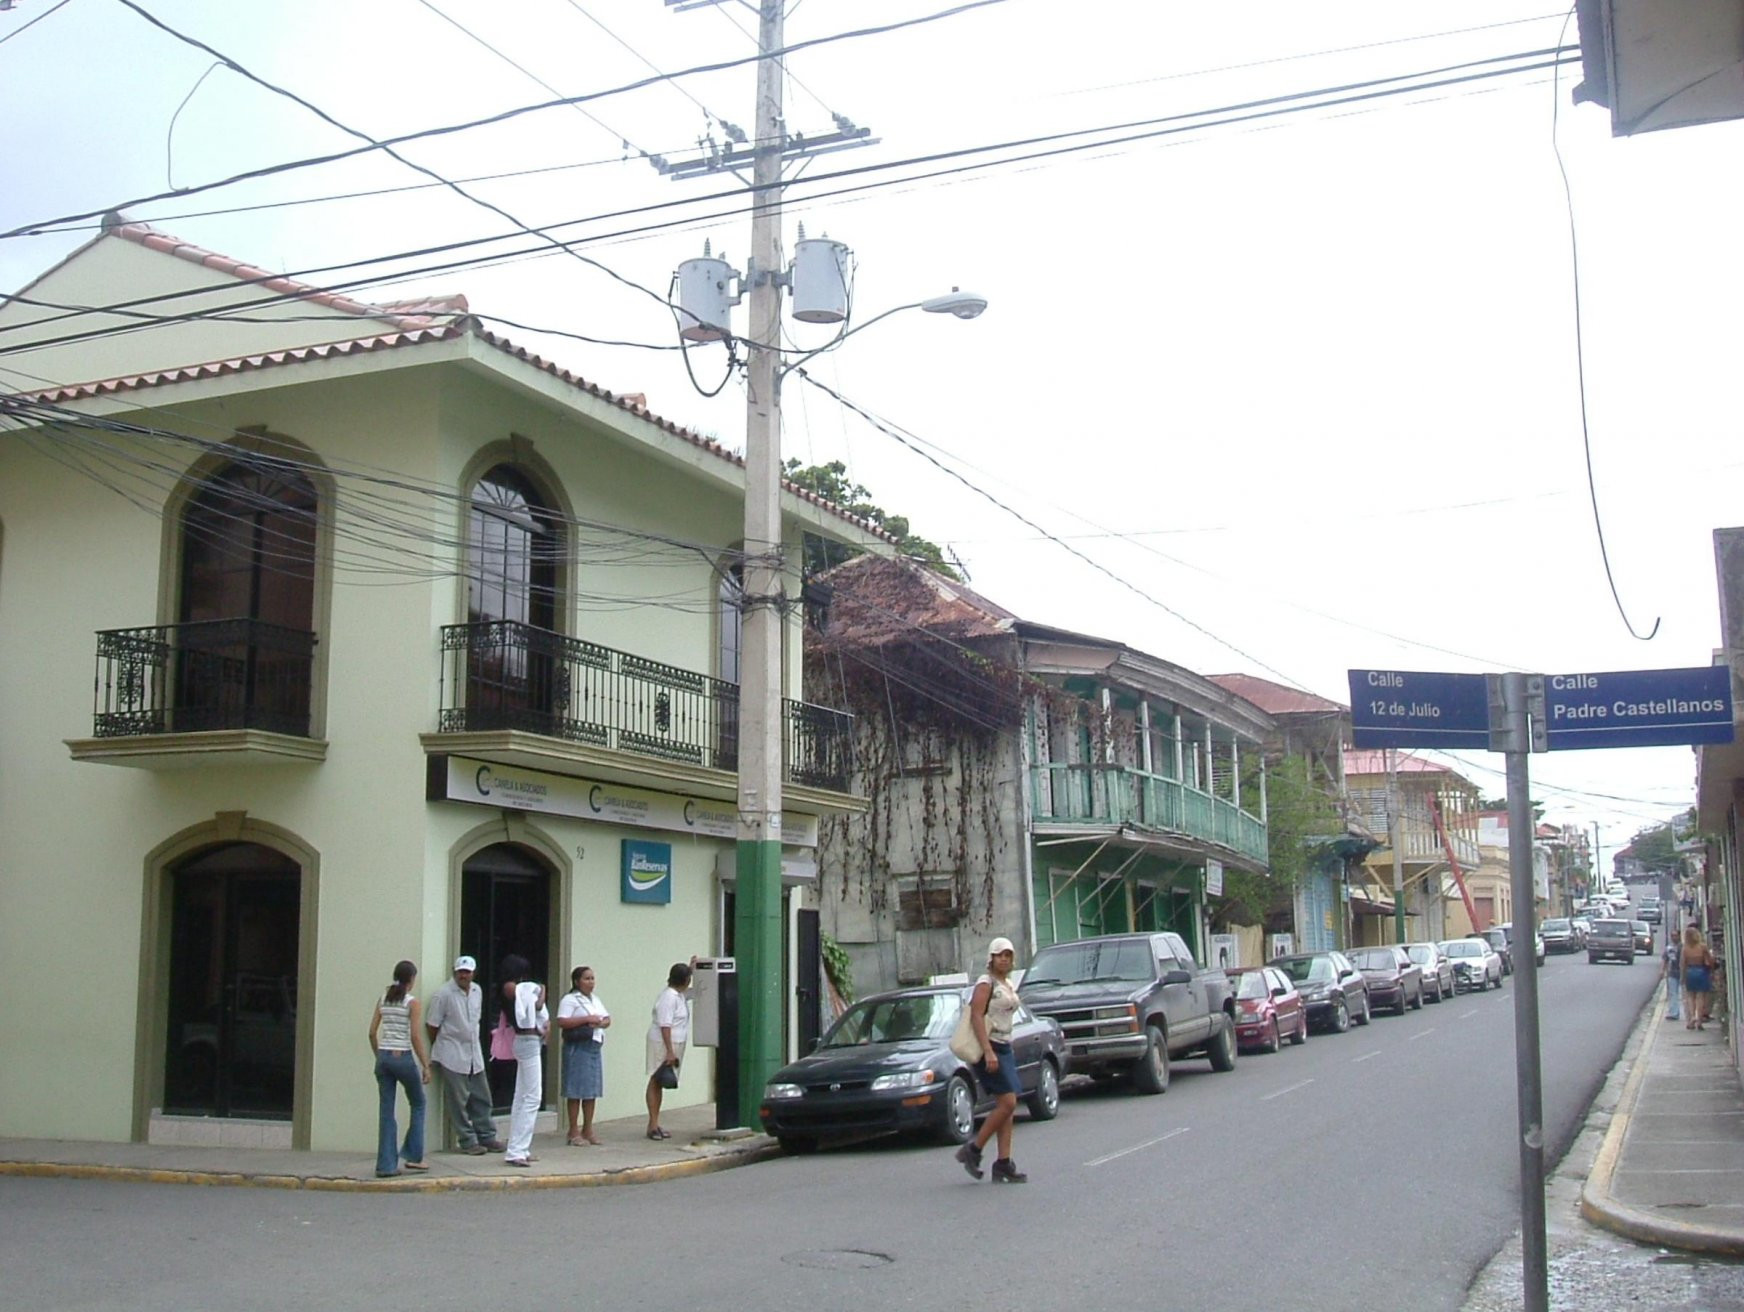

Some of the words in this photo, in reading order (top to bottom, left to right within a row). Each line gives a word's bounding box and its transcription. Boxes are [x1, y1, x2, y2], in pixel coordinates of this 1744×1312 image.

[1367, 671, 1404, 687] Calle
[1552, 674, 1598, 690] Calle
[1370, 701, 1385, 715] 12
[1389, 701, 1405, 716] de
[1409, 702, 1440, 717] Julio
[1554, 703, 1607, 719] Padre
[1613, 698, 1724, 717] Castellanos
[576, 846, 584, 859] 52
